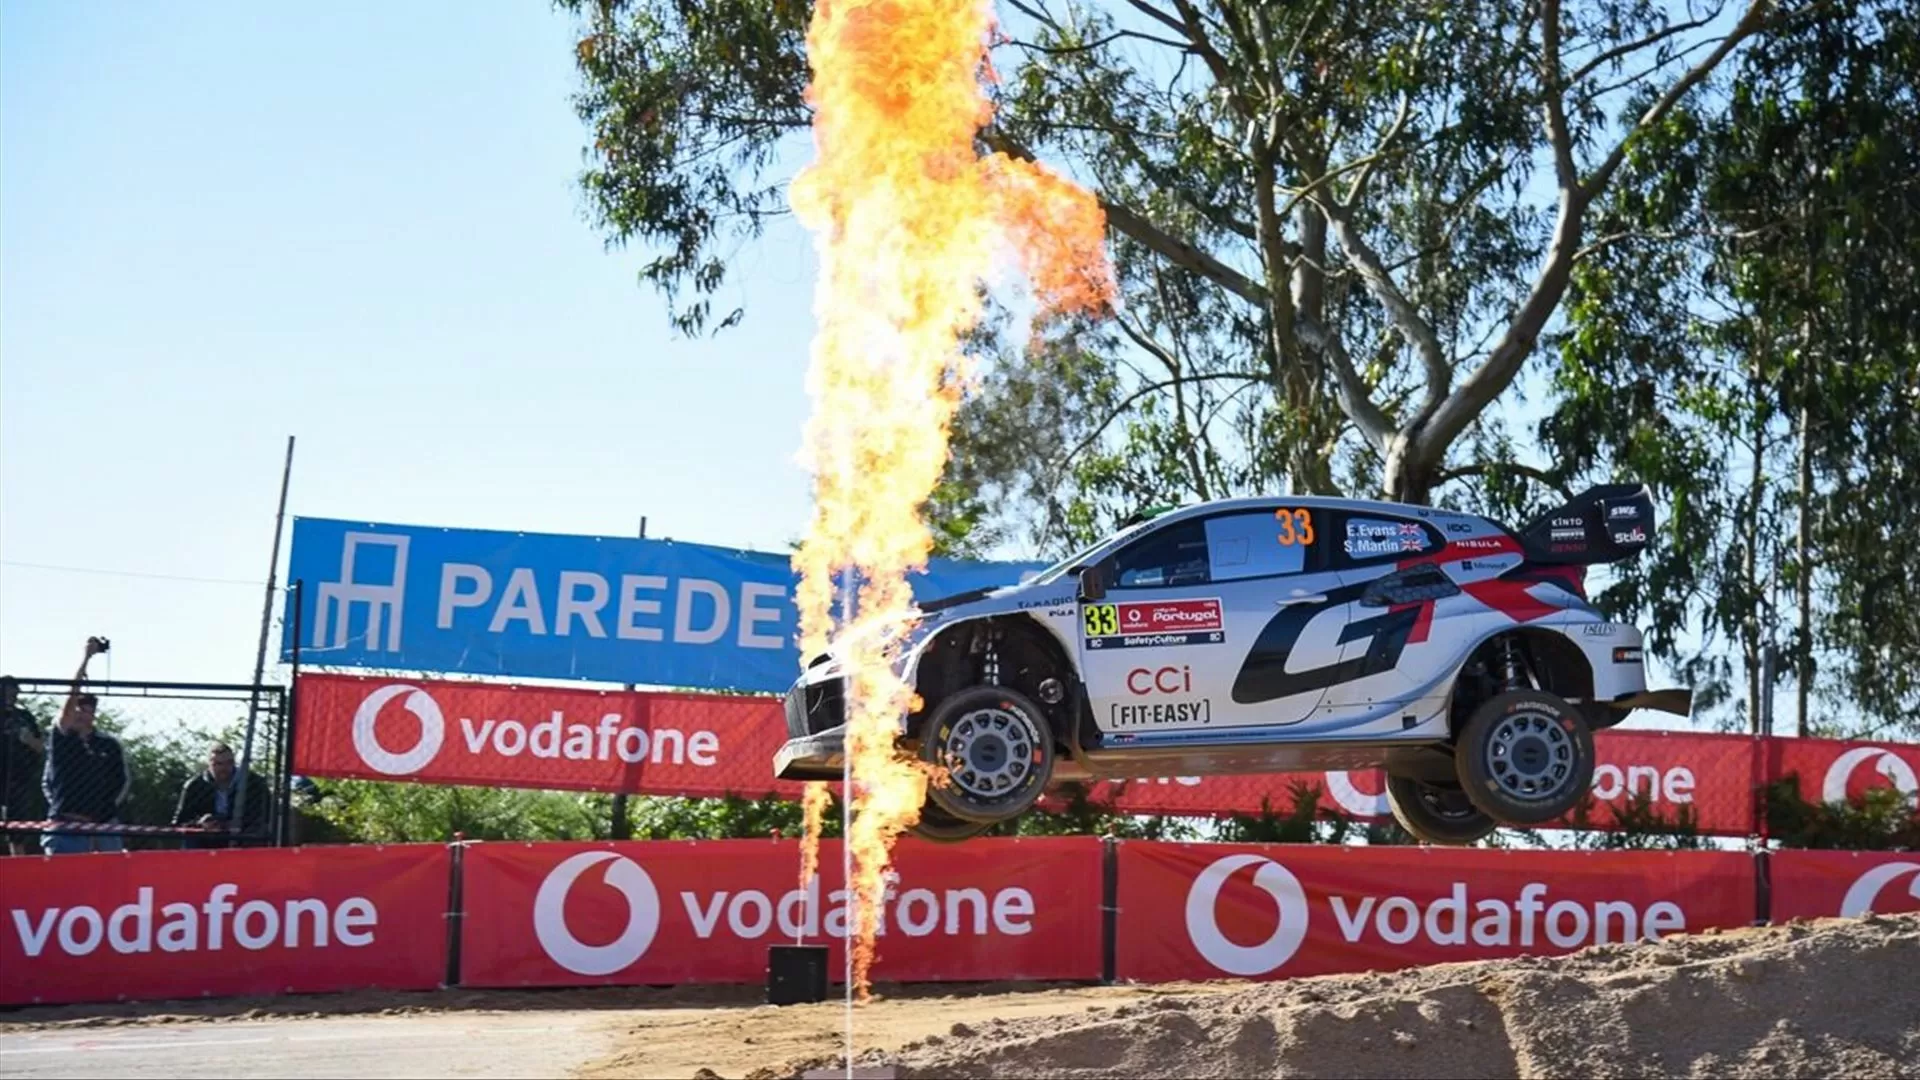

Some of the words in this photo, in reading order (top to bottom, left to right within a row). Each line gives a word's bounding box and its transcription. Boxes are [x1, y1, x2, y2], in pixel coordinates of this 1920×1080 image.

[1275, 508, 1315, 546] 33
[1344, 539, 1399, 554] S.Martin
[1346, 523, 1397, 538] E.Evans
[436, 562, 787, 649] PAREDE
[1086, 604, 1118, 636] 33
[1152, 609, 1218, 622] Portugal
[460, 711, 719, 766] vodafone
[10, 883, 378, 956] vodafone
[680, 871, 1035, 939] vodafone
[1329, 882, 1685, 948] vodafone
